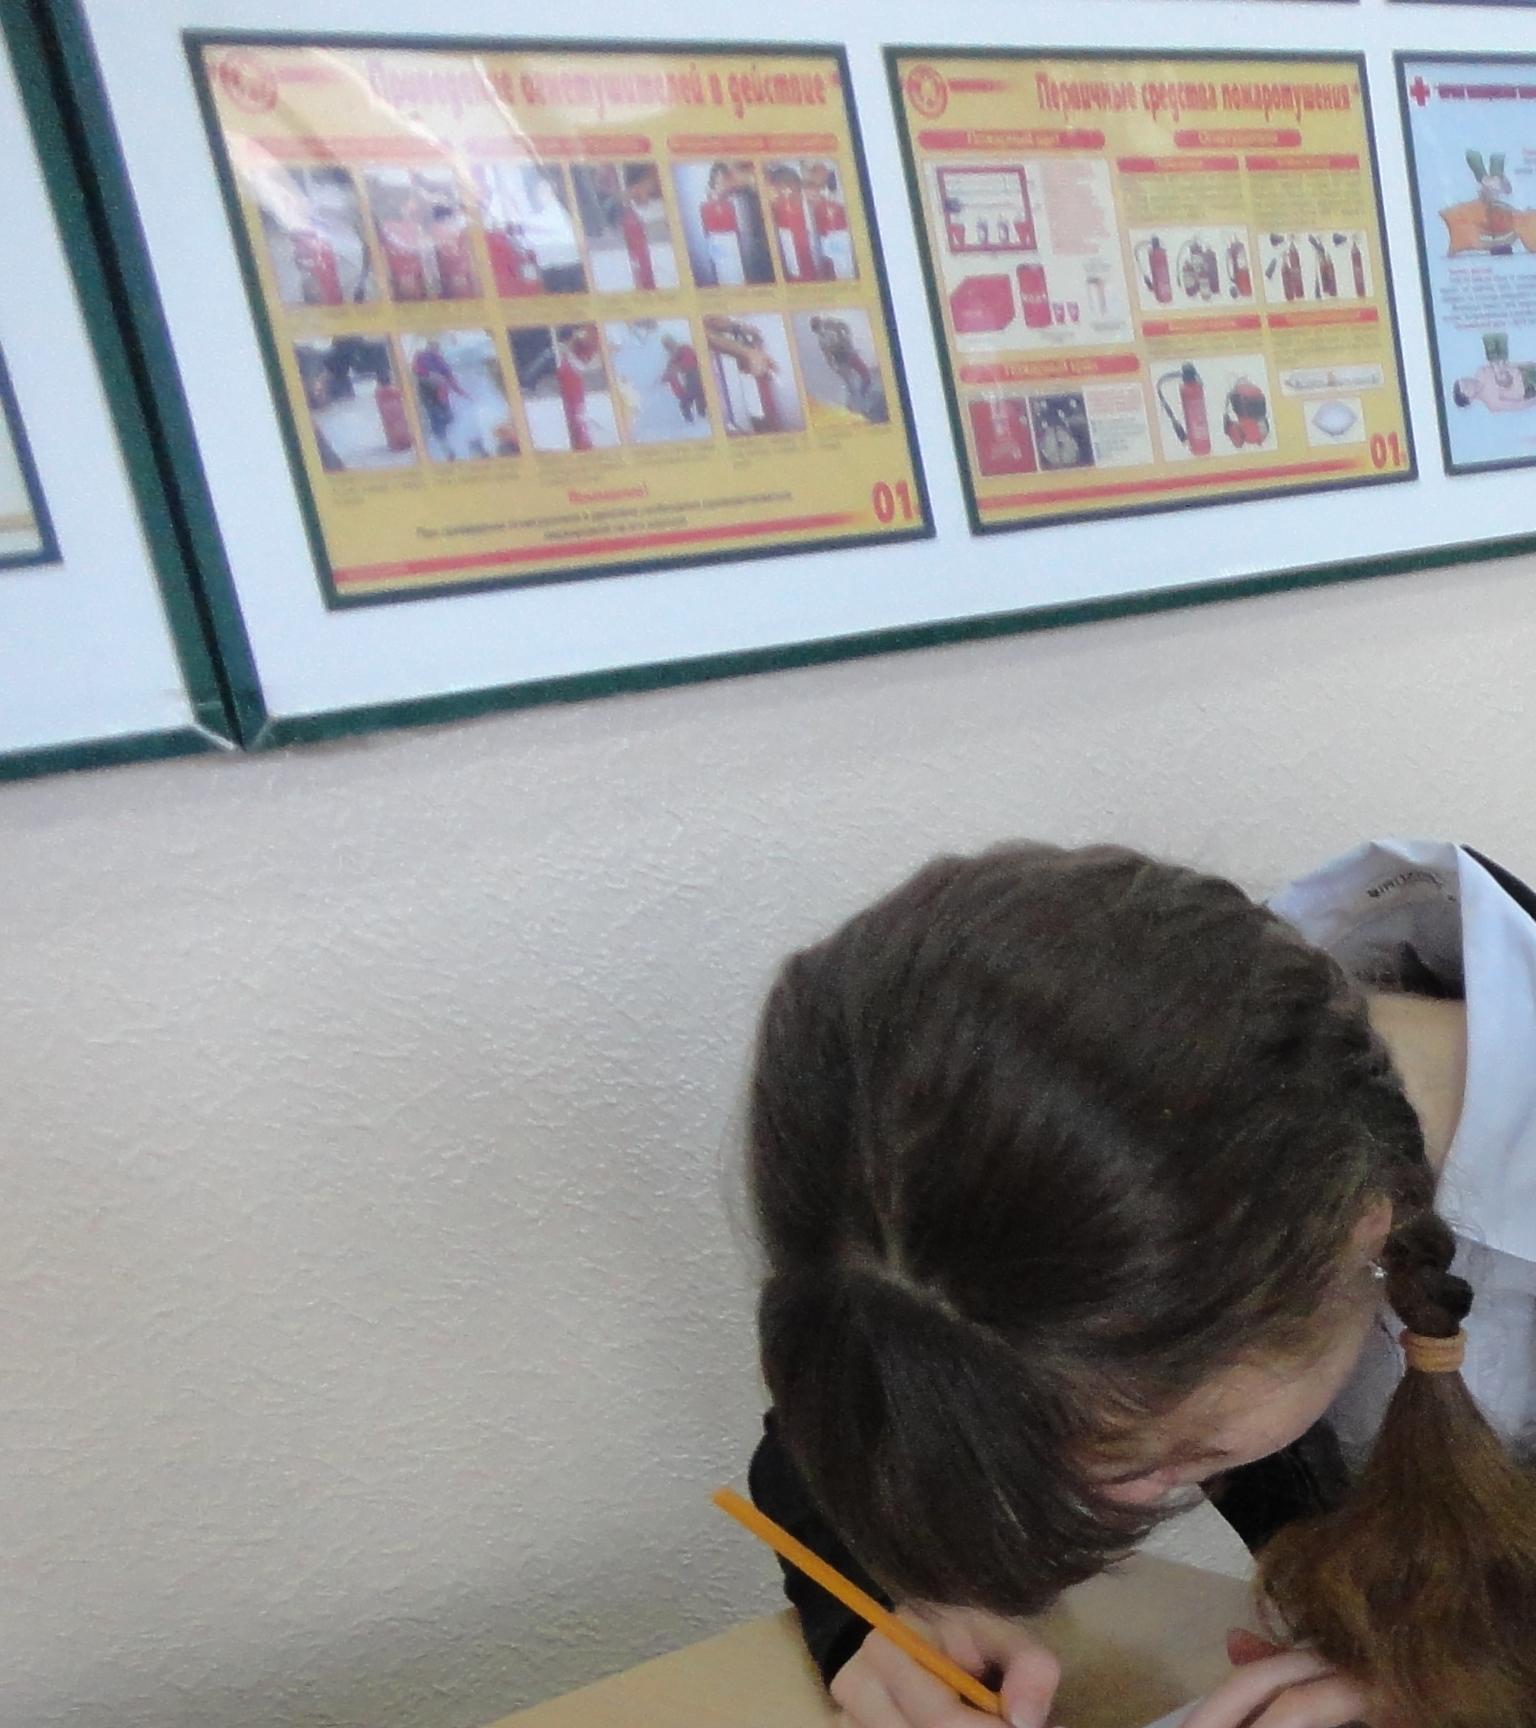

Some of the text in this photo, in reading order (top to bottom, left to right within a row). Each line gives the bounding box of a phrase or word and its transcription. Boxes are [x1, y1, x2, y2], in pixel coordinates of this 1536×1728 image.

[729, 64, 826, 119] действие
[1034, 71, 1350, 123] Первичные средства пожаротушения
[1369, 431, 1401, 469] 01
[872, 479, 914, 522] 01
